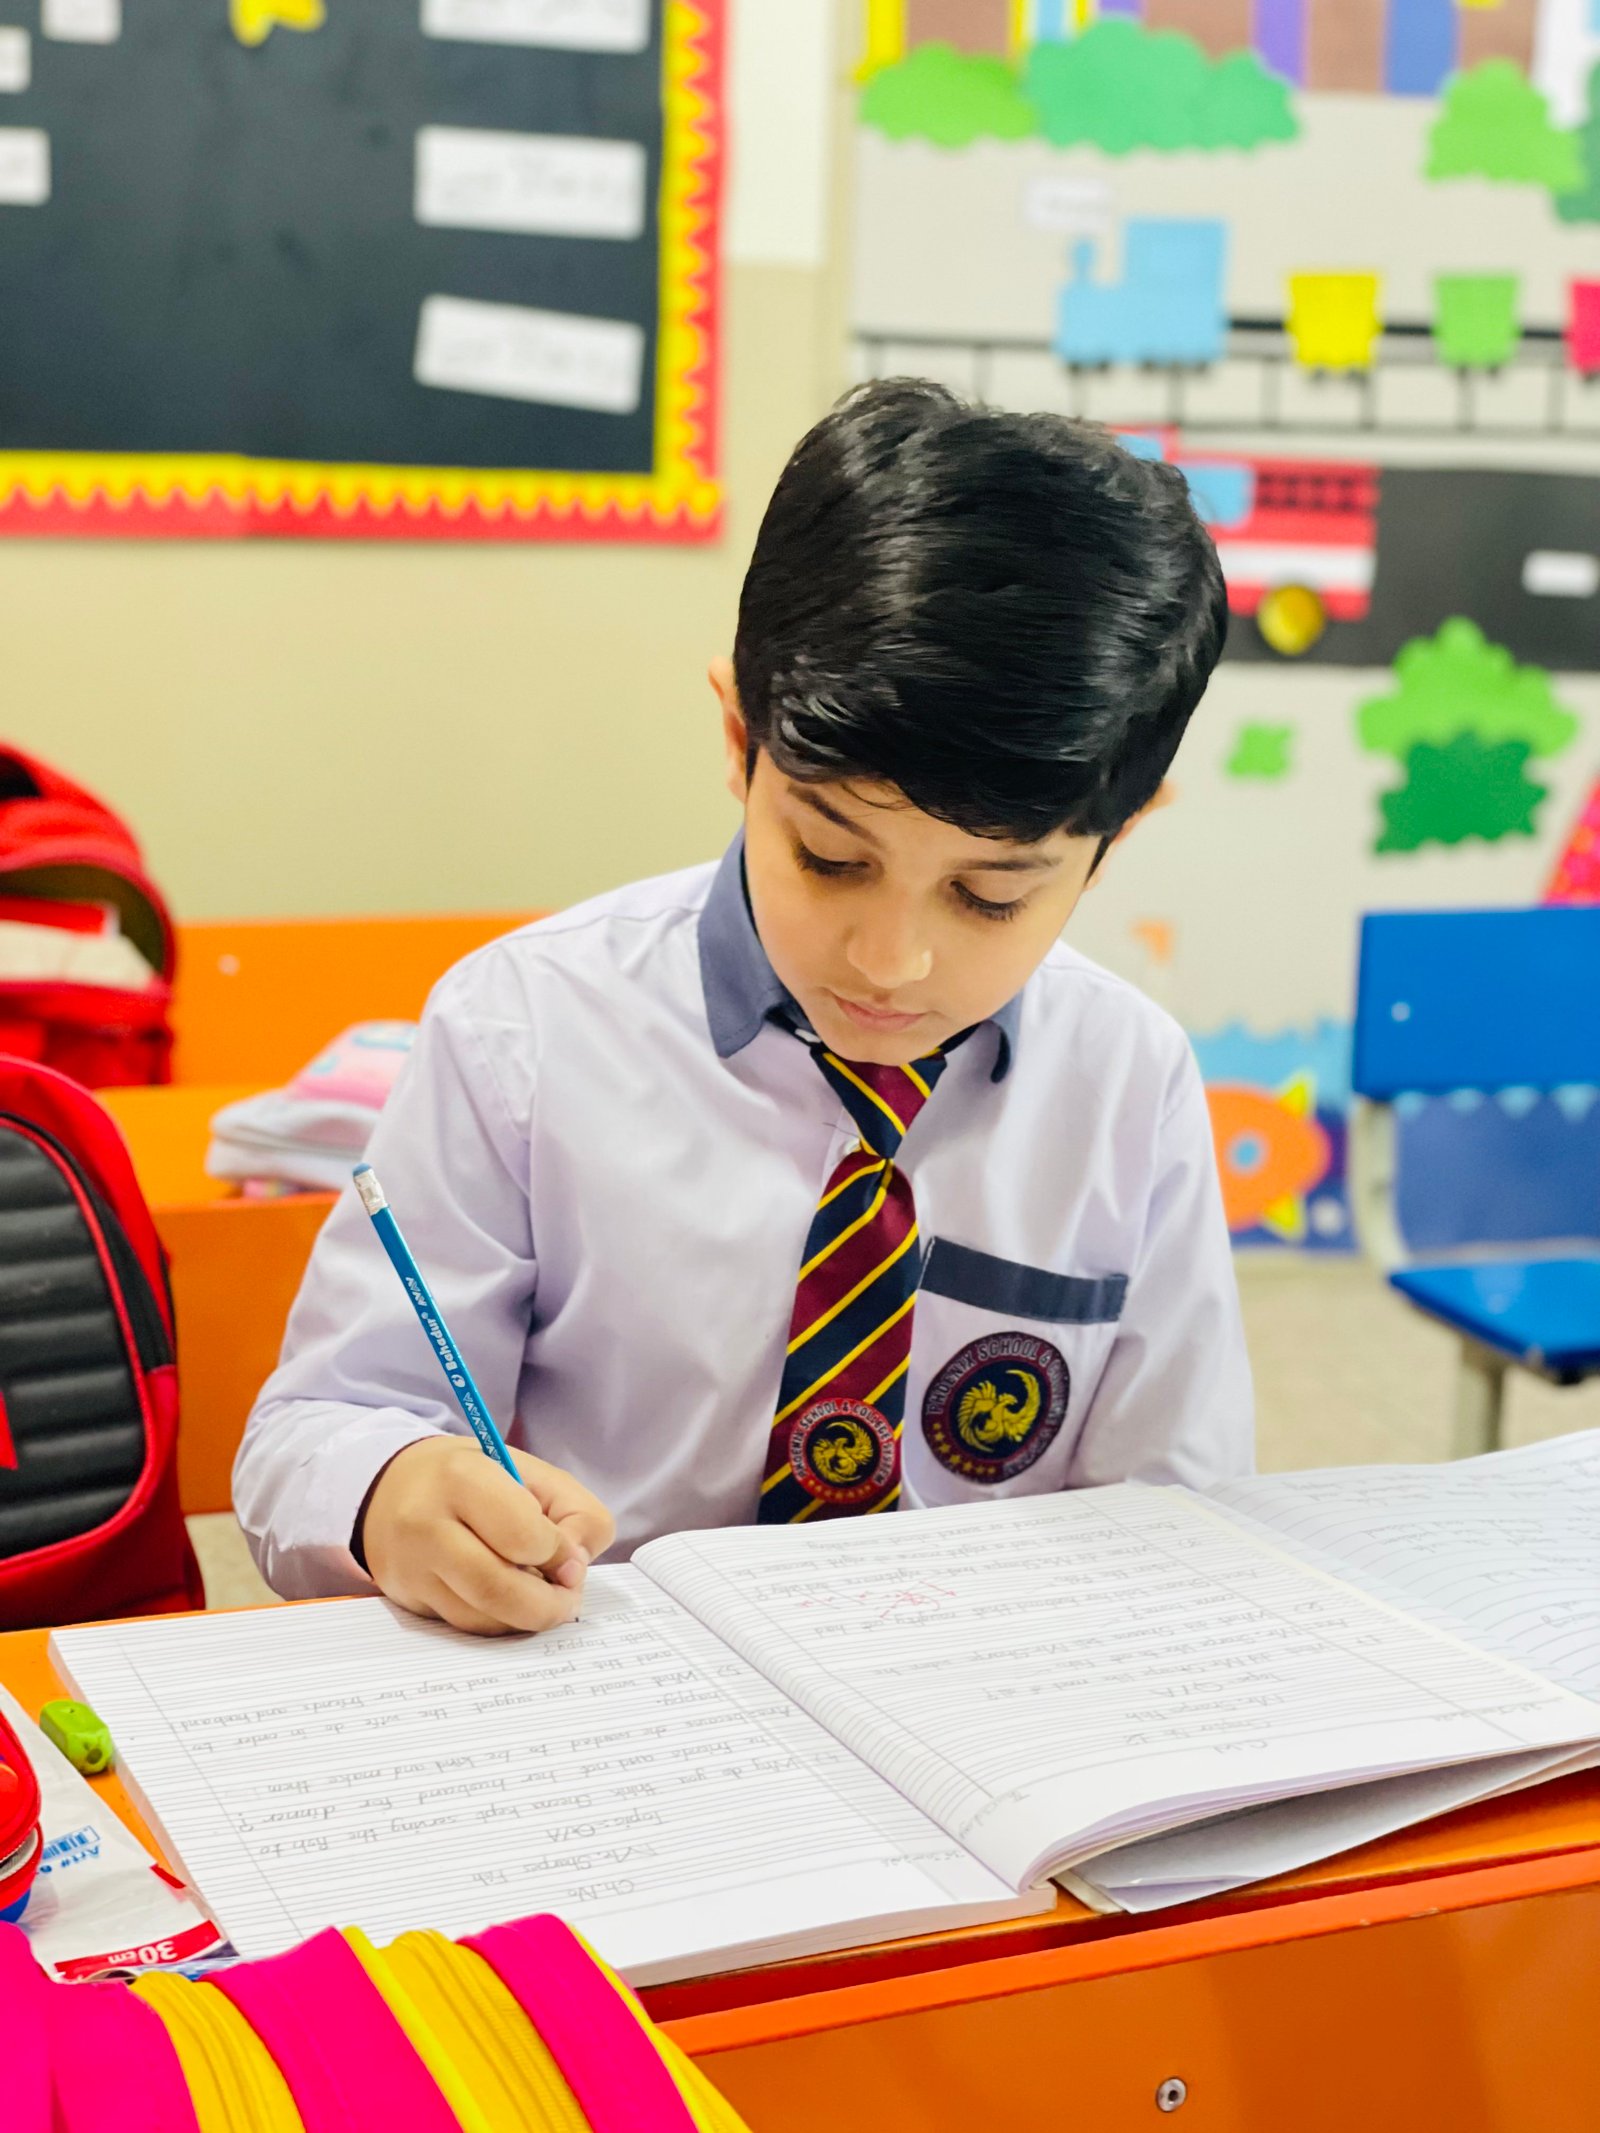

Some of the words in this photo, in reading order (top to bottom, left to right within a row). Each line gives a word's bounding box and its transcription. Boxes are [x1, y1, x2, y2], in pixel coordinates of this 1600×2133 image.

[427, 1319, 458, 1371] Bahadur
[926, 1350, 978, 1415] PHOENIX
[977, 1338, 1039, 1361] SCHOOL
[790, 1428, 806, 1481] PHOENIX
[800, 1402, 839, 1431] SCHOOL
[841, 1400, 849, 1413] &
[466, 1677, 498, 1690] and
[374, 1690, 406, 1701] her
[546, 1685, 575, 1699] you
[418, 1708, 448, 1720] the
[192, 1742, 214, 1752] to
[529, 1744, 547, 1757] to
[327, 1769, 382, 1787] make
[394, 1763, 425, 1780] and
[521, 1770, 556, 1783] her
[678, 1768, 707, 1783] you
[722, 1767, 742, 1779] do
[267, 1780, 310, 1793] them
[360, 1796, 392, 1810] for
[263, 1804, 335, 1824] dinner
[391, 1815, 456, 1834] serving
[349, 1828, 378, 1843] the
[259, 1843, 285, 1857] to
